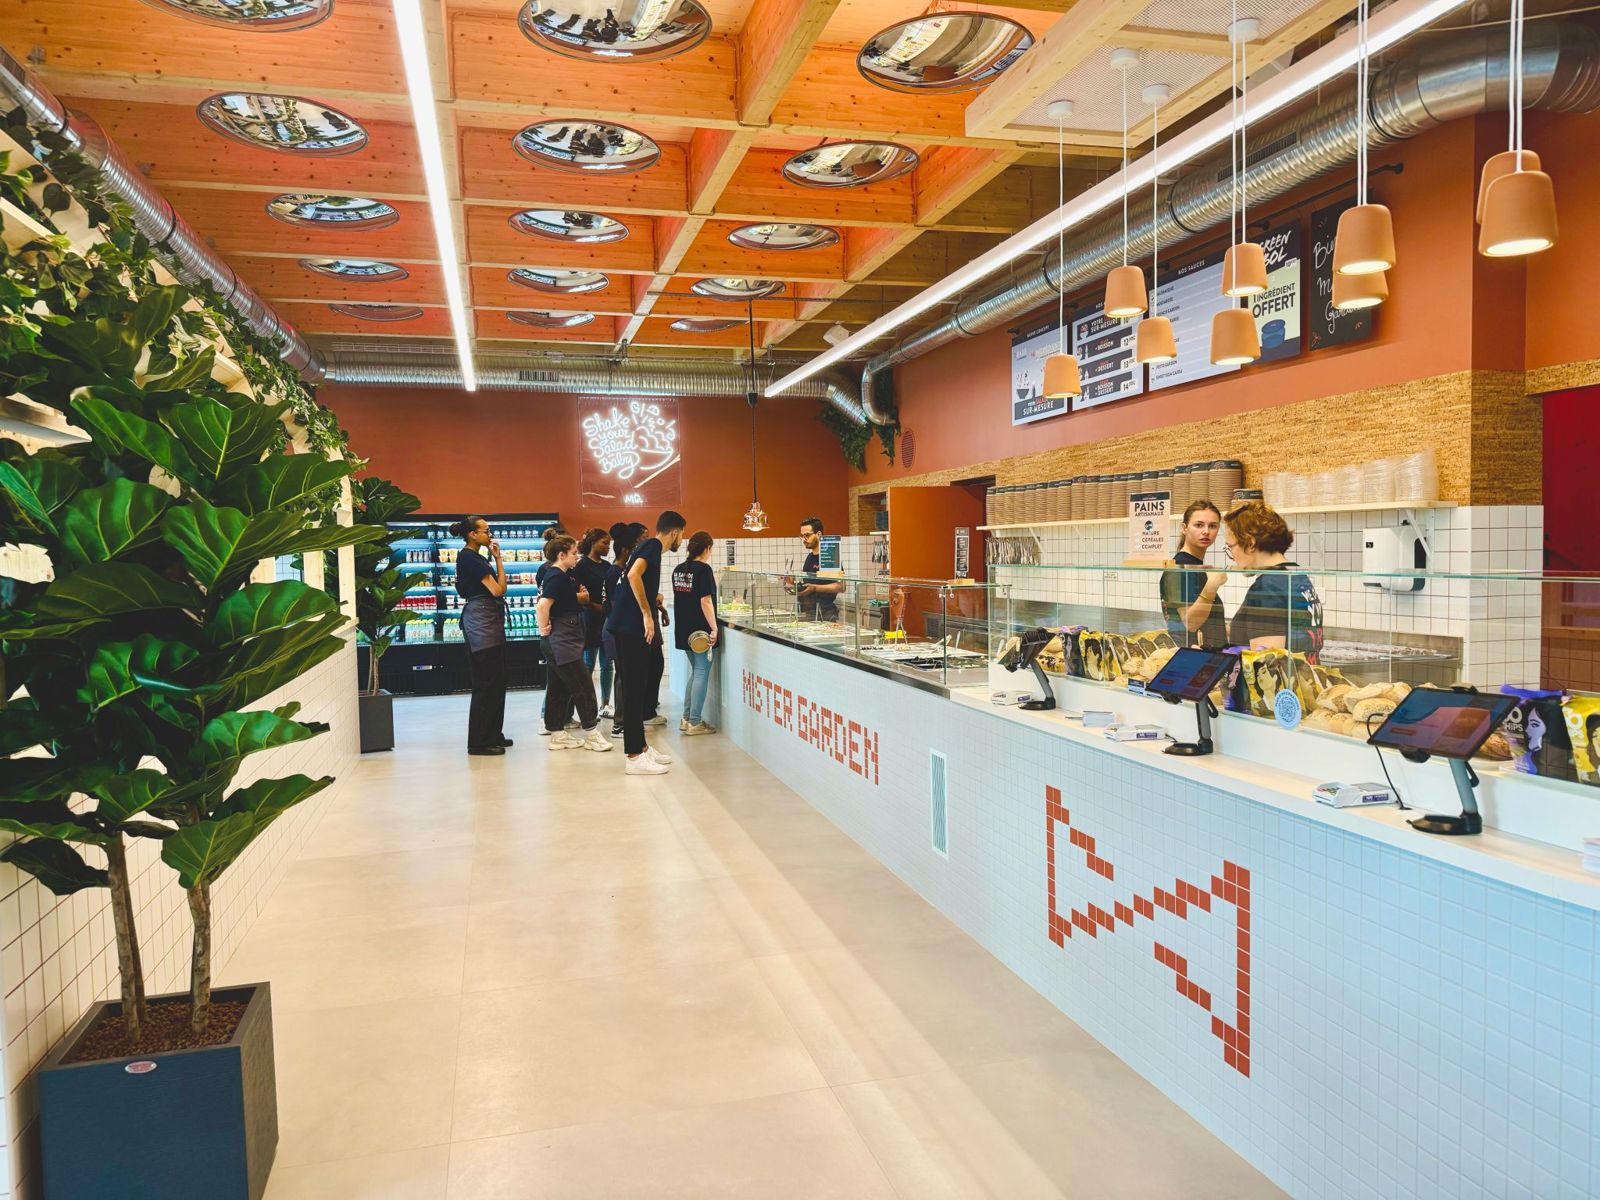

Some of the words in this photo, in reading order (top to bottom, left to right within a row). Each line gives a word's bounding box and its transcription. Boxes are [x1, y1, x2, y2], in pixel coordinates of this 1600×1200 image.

[1261, 230, 1292, 252] REEN
[1257, 282, 1296, 301] INGRÉDIENT
[1252, 292, 1296, 318] OFFERT
[1023, 401, 1054, 415] SUR-MESURE
[582, 407, 630, 438] Shake
[588, 431, 640, 458] Salad
[598, 429, 631, 446] your
[598, 451, 640, 480] Baby
[1134, 501, 1165, 512] PAINS
[743, 669, 793, 732] MISTER
[798, 695, 879, 786] GARDEN
